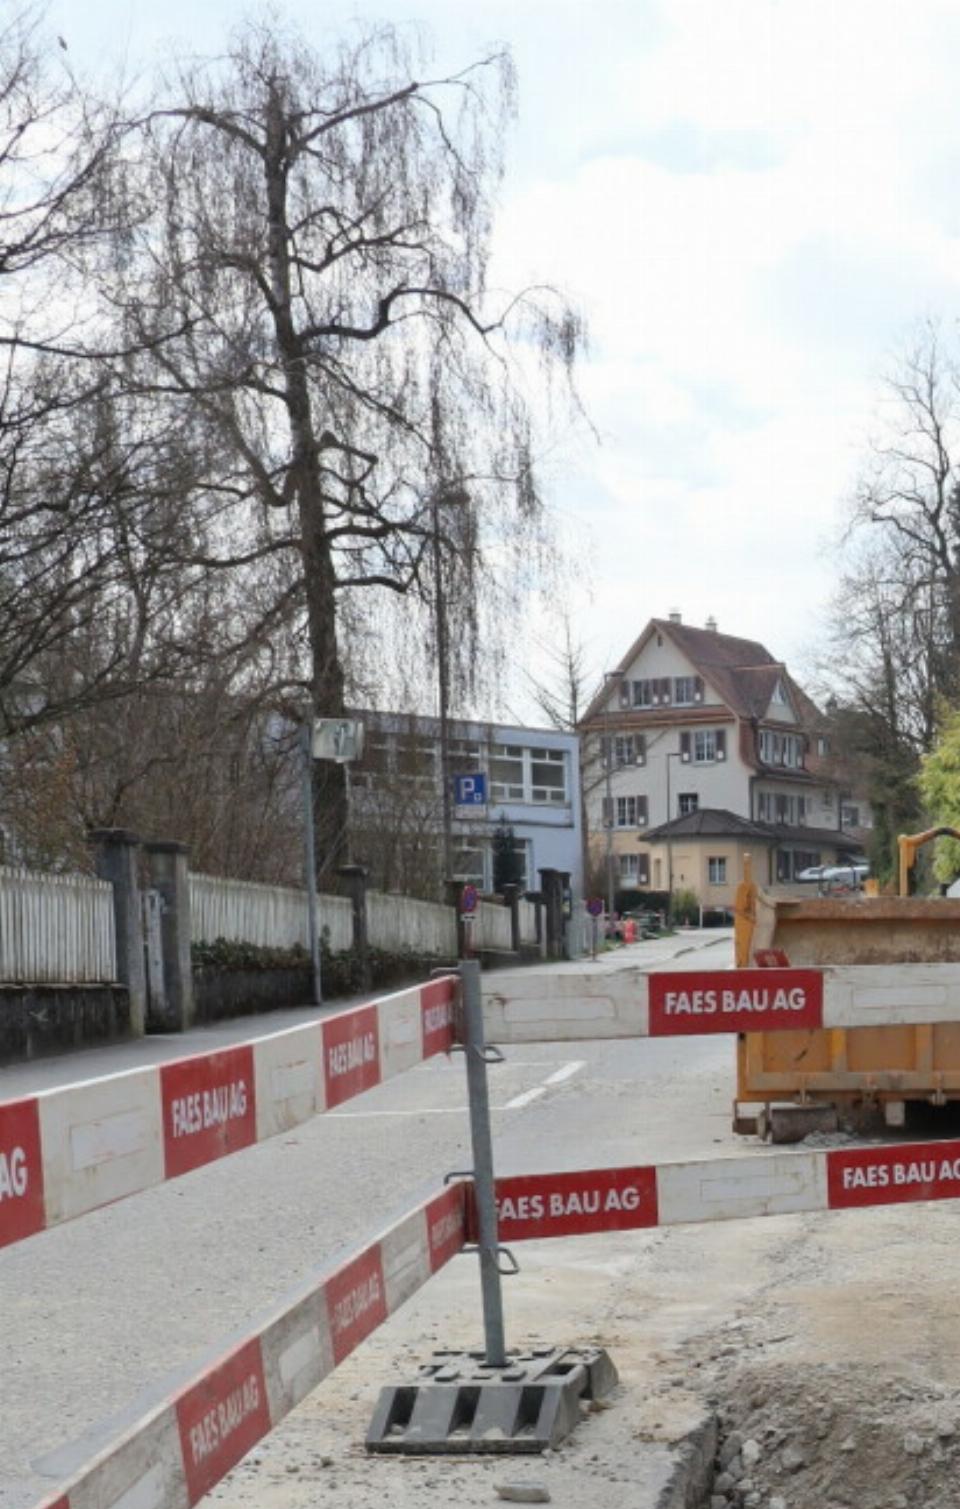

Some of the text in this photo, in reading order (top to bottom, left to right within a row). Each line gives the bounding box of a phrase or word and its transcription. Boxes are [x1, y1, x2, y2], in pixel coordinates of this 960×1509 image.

[460, 778, 475, 800] P
[664, 987, 806, 1015] FAES BAU AG
[171, 1080, 248, 1138] FAES BAU AG
[843, 1165, 889, 1190] FAES
[892, 1160, 936, 1184] BAU
[549, 1190, 600, 1217] BAU
[604, 1187, 641, 1212] AG
[190, 1373, 260, 1467] FAES BAU AG
